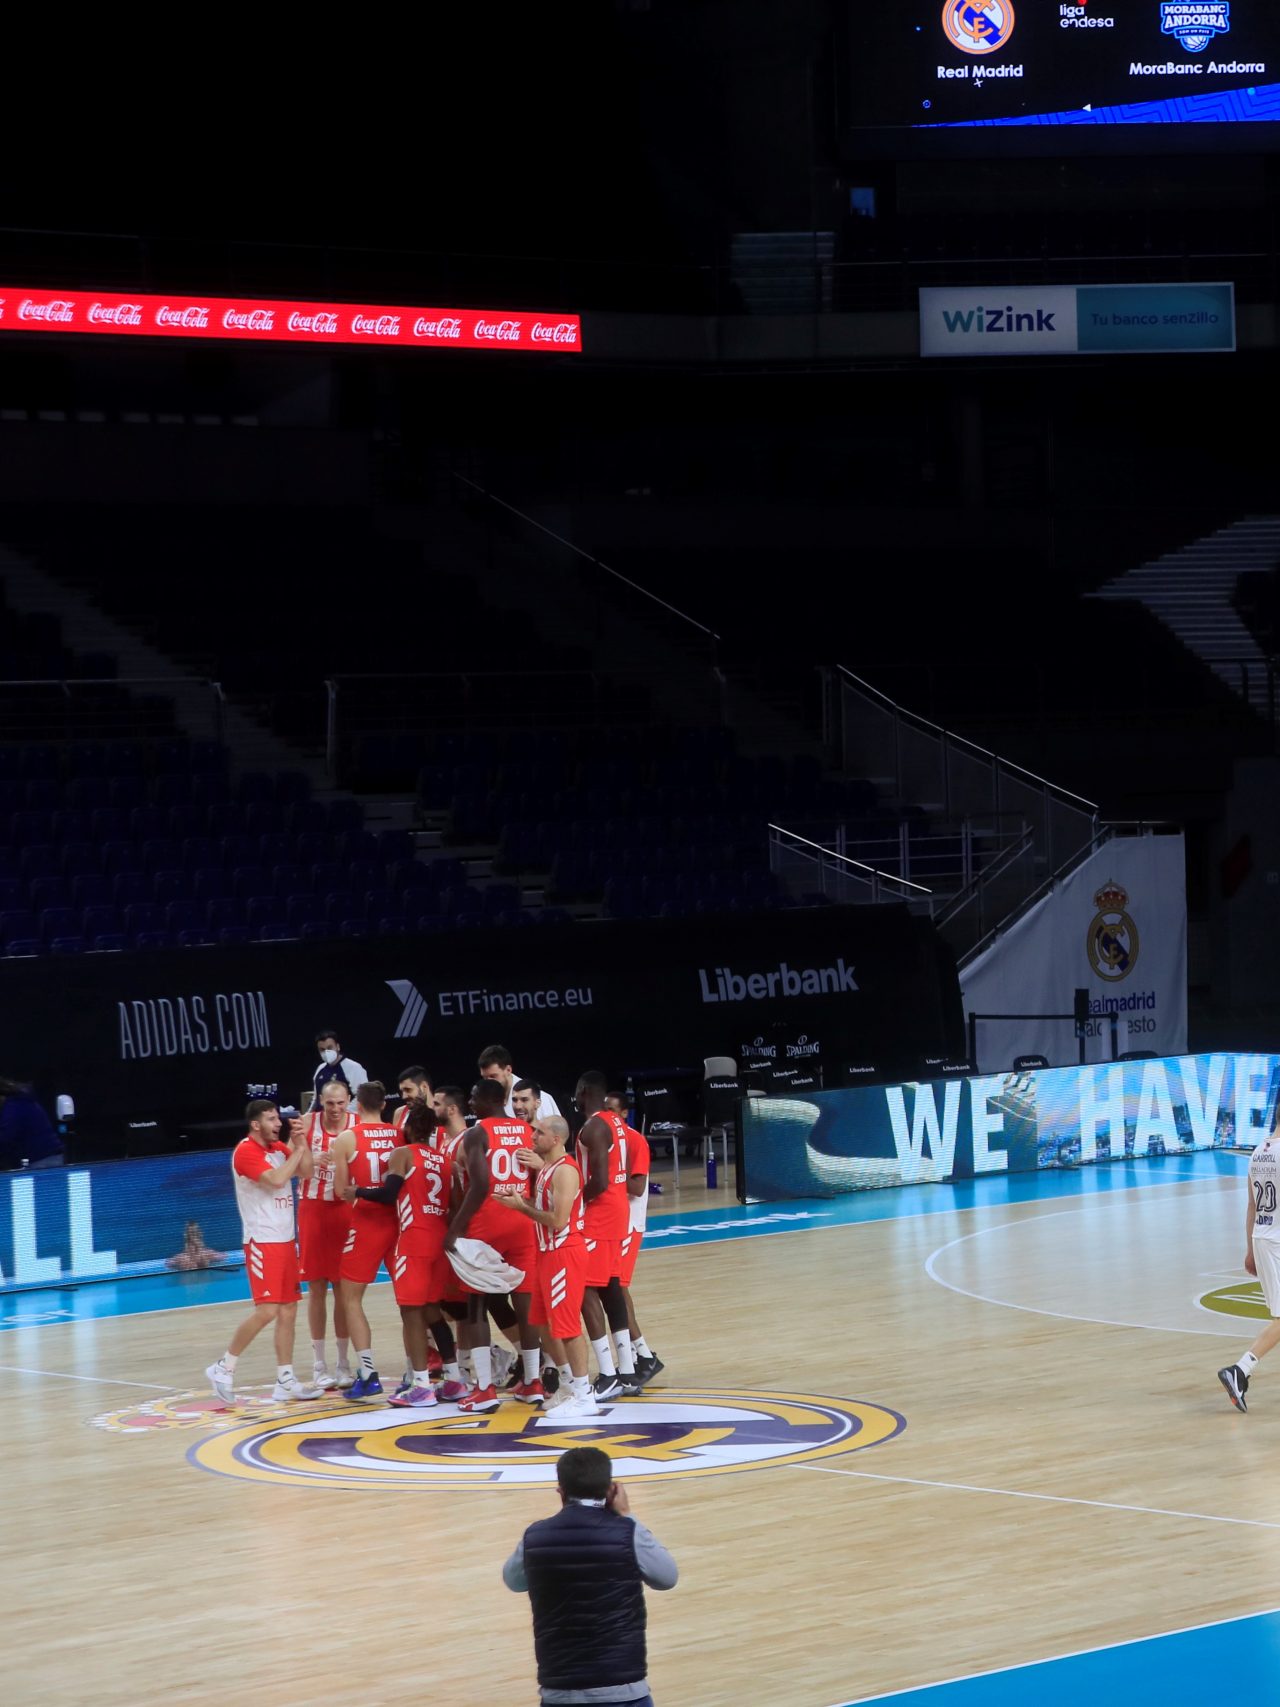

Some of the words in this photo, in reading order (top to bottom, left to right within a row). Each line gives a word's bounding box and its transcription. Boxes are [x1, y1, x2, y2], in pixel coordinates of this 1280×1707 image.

[1059, 4, 1085, 19] liga
[1164, 4, 1226, 15] MORABANC
[1060, 16, 1114, 28] endesa
[1164, 14, 1227, 28] ANDORRA
[937, 65, 968, 79] Real
[972, 64, 1023, 78] Madrid
[1129, 62, 1203, 76] MoraBanc
[1207, 61, 1265, 73] Andorra
[942, 306, 1056, 334] WiZink
[1091, 314, 1107, 326] Tu
[1110, 311, 1158, 326] banco
[700, 958, 860, 1003] Liberbank
[439, 985, 593, 1016] ETFinance.eu
[1087, 991, 1156, 1014] ealmadrid
[118, 992, 271, 1060] ADIDAS.COM
[786, 1041, 820, 1057] SPALDING
[644, 1088, 668, 1096] Liberbank
[886, 1076, 1009, 1183] WE
[1079, 1056, 1270, 1160] HAVE
[363, 1129, 398, 1138] RADANOV
[426, 1172, 443, 1206] 2
[1253, 1180, 1277, 1213] 20
[0, 1170, 118, 1287] LL
